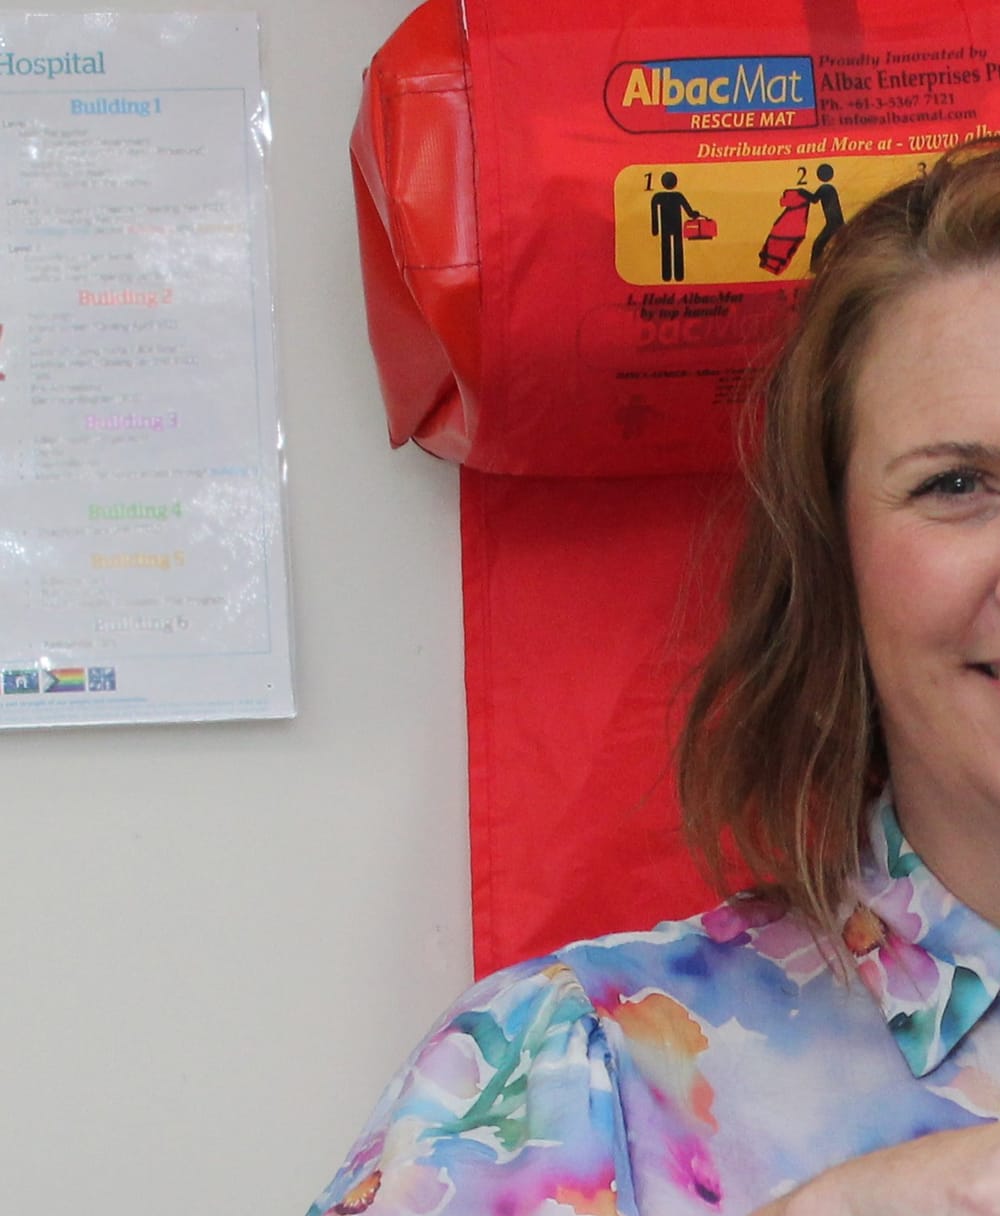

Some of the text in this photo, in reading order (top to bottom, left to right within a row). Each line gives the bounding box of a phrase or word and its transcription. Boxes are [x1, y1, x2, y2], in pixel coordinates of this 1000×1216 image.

[0, 51, 106, 79] Hospital
[819, 45, 988, 68] Proudly Innovated by
[622, 63, 804, 107] AlbacMat
[821, 70, 872, 91] Albac
[877, 65, 981, 92] Enterprises
[70, 97, 162, 117] Building 1
[820, 98, 843, 110] Ph.
[923, 92, 955, 105] 7121
[690, 111, 796, 129] RESCUE MAT
[839, 107, 977, 125] info@albacmat.com
[697, 141, 792, 158] Distributors
[796, 138, 826, 154] and
[831, 136, 873, 152] More
[878, 138, 892, 151] at
[643, 172, 654, 191] 1
[796, 167, 808, 185] 2
[77, 287, 174, 309] Building 2
[642, 292, 676, 306] Hold
[640, 304, 730, 321] by top handle
[85, 409, 180, 432] Building 3
[87, 500, 183, 522] Building 4
[90, 549, 186, 570] Building 5
[94, 615, 189, 636] Building 6
